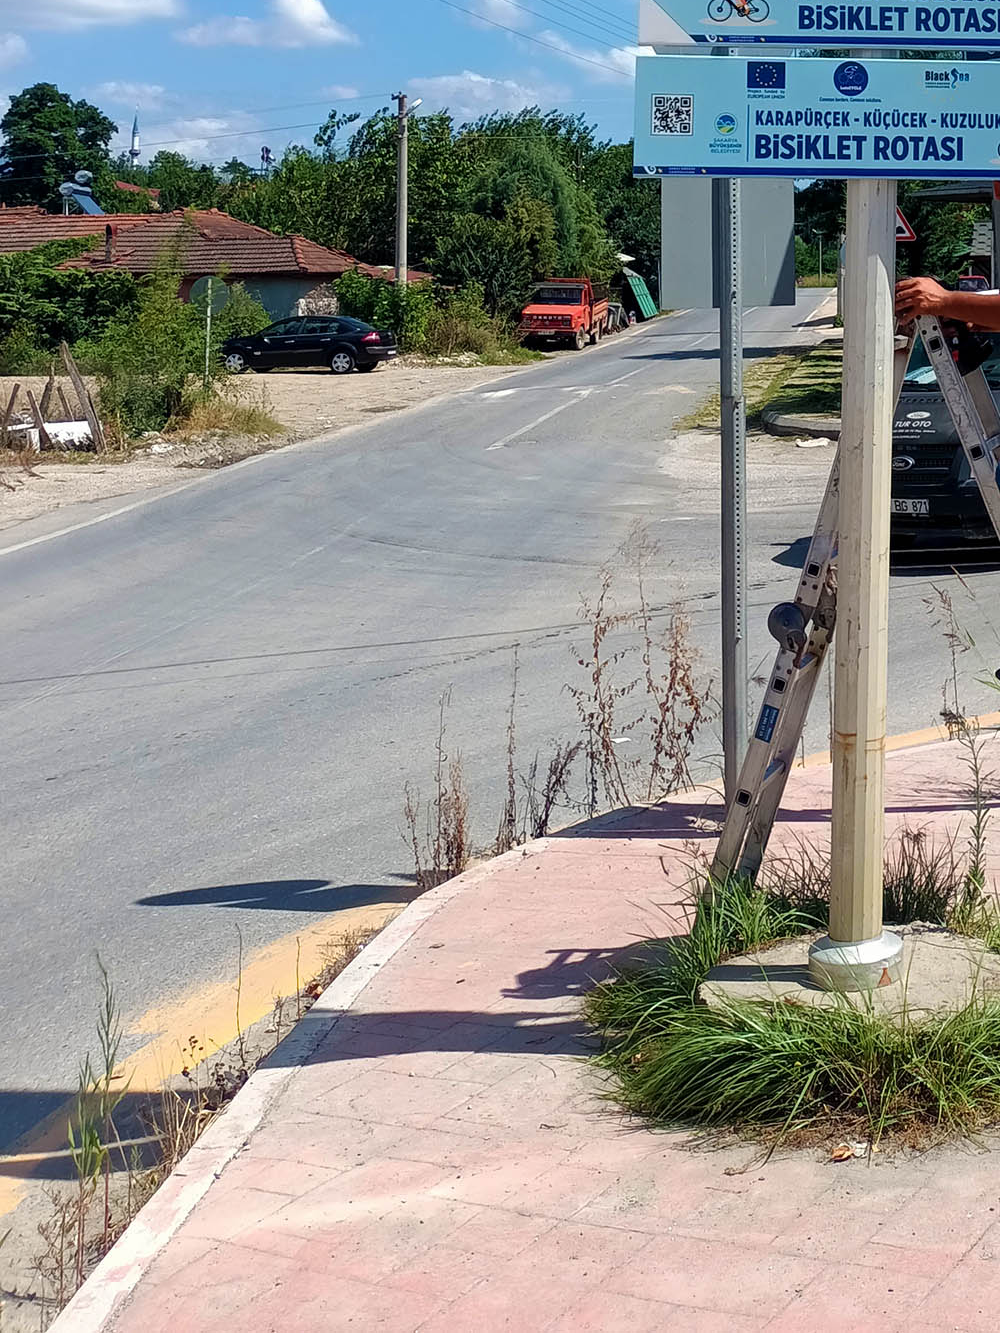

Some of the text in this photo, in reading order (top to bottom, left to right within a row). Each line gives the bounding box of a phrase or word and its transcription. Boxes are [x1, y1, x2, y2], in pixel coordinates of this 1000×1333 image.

[925, 70, 950, 81] Black
[755, 108, 850, 130] KARAPÜRÇEK
[863, 108, 928, 131] KÜÇÜCEK
[873, 135, 964, 161] ROTASI
[894, 500, 928, 512] BG 871
